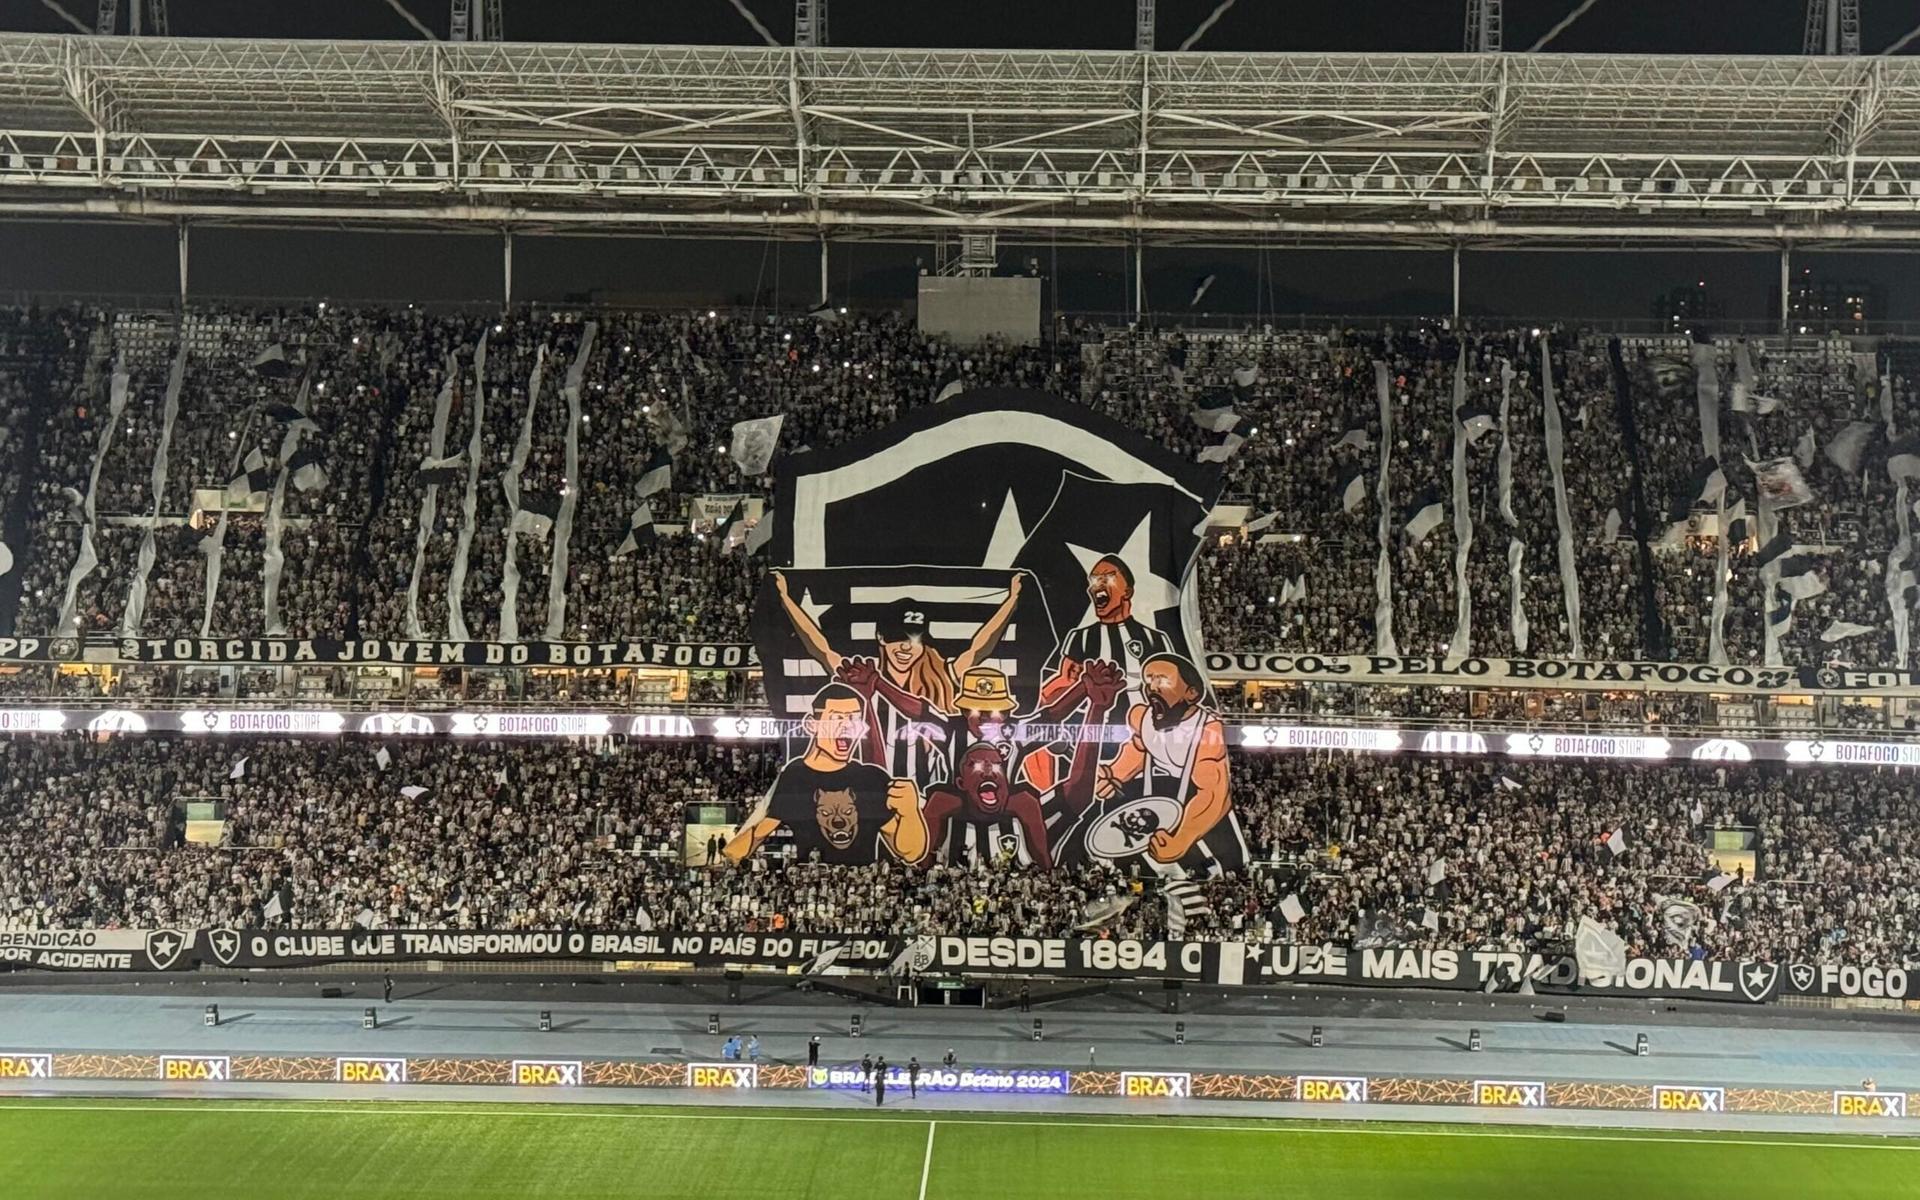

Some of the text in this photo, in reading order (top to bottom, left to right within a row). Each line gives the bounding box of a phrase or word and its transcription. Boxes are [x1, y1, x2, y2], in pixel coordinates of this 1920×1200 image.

[904, 611, 924, 624] 22
[147, 639, 741, 666] TORCIDA JOVEM DO BOTAFOGO
[1206, 654, 1351, 675] OUCO
[1367, 657, 1489, 675] PELO
[1506, 659, 1753, 686] BOTAFOGO
[230, 714, 291, 729] BOTAFOGO
[499, 716, 558, 732] BOTAFOGO
[1289, 729, 1348, 746] BOTAFOGO
[1555, 737, 1616, 755] BOTAFOGO
[1836, 744, 1899, 762] BOTAFOGO
[251, 936, 268, 957] O
[274, 936, 345, 956] CLUBE
[401, 934, 562, 955] TRANSFORMOU
[568, 934, 585, 954] O
[591, 935, 664, 954] BRASIL
[672, 937, 703, 955] NO
[709, 934, 756, 956] PAÍS
[762, 938, 793, 957] DO
[37, 951, 132, 969] ACIDENTE
[941, 936, 1066, 968] DESDE
[1080, 940, 1166, 971] 1894
[1361, 948, 1459, 980] MAIS
[1821, 965, 1907, 998] FOGO
[0, 1057, 46, 1078] RAX
[166, 1060, 224, 1080] BRAX
[343, 1063, 401, 1083] BRAX
[519, 1065, 577, 1086] BRAX
[694, 1068, 751, 1089] BRAX
[1016, 1075, 1061, 1088] 2024
[1126, 1076, 1184, 1097] BRAX
[1303, 1080, 1361, 1101] BRAX
[1481, 1085, 1539, 1106] BRAX
[1659, 1090, 1718, 1111] BRAX
[1841, 1096, 1899, 1117] BRAX
